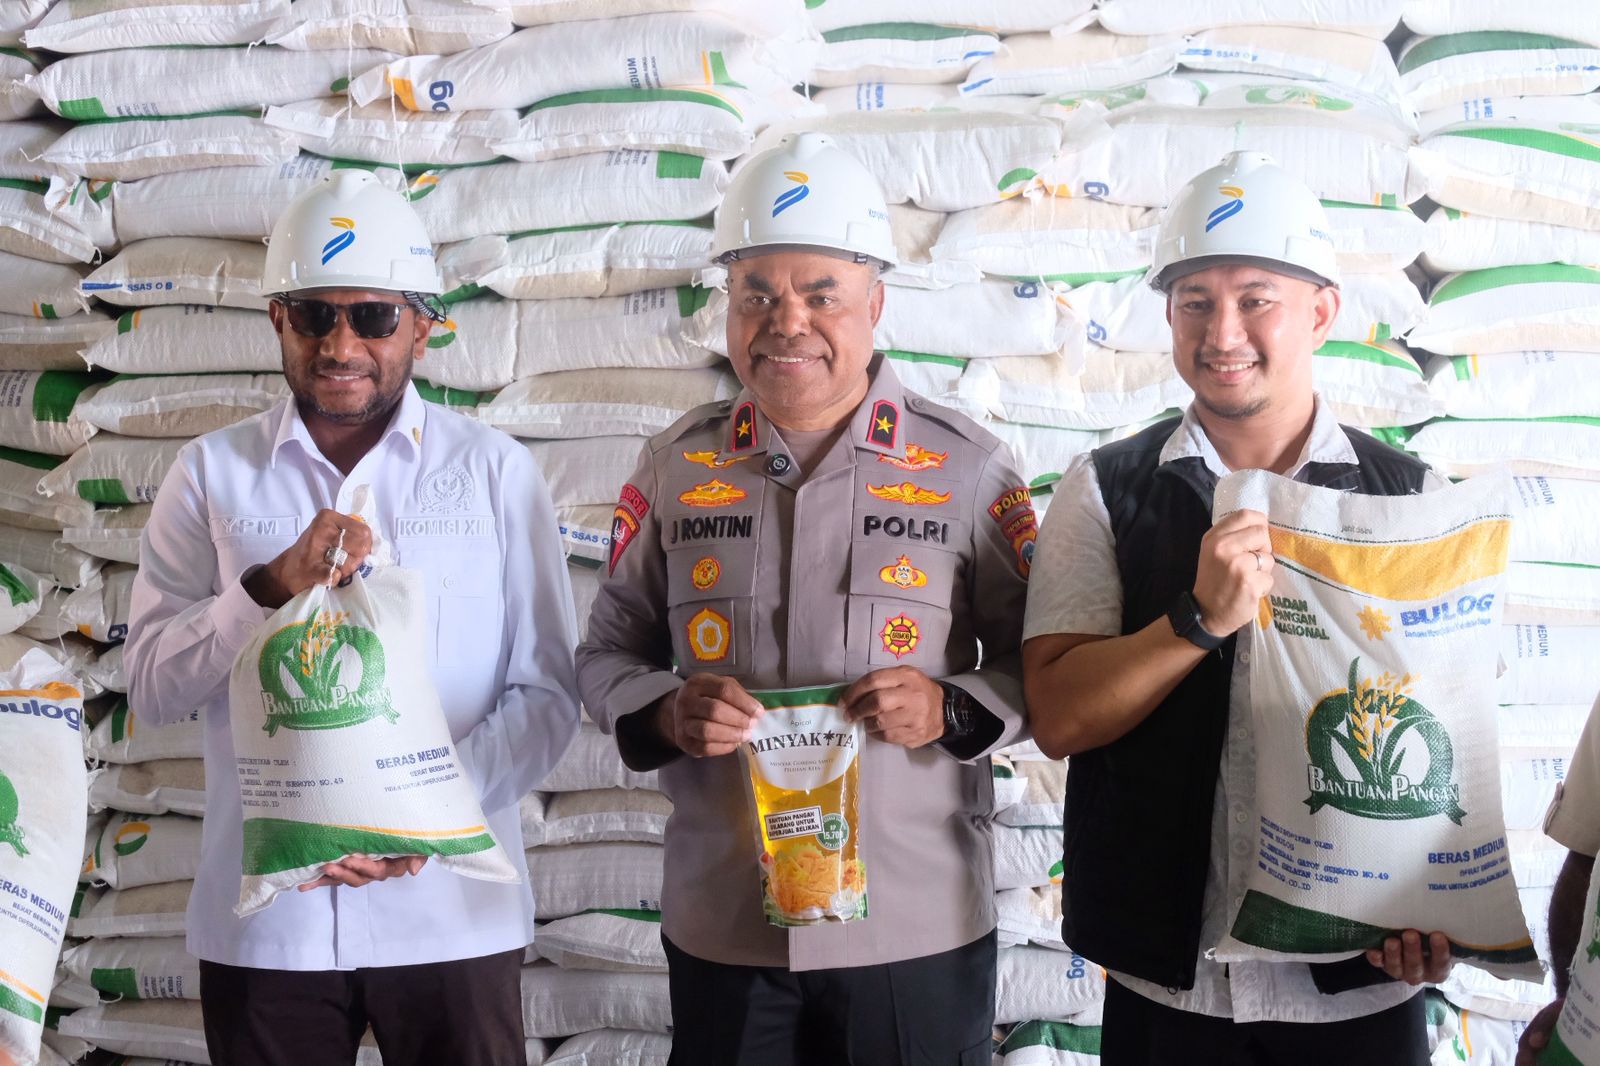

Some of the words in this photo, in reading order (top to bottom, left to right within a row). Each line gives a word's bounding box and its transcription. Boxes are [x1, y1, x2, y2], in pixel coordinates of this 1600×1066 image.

[627, 57, 641, 89] EDIUM
[400, 519, 460, 536] KOMISI
[671, 520, 678, 545] J
[681, 515, 753, 542] RONTINI
[863, 515, 949, 546] POLRI
[1400, 593, 1495, 626] BULOG
[0, 699, 81, 732] ulog
[261, 690, 328, 715] BANTUAN
[376, 754, 416, 769] BERAS
[417, 745, 451, 762] MEDIUM
[1307, 763, 1388, 801] BANTUAN
[1390, 773, 1460, 802] PANGAN
[1428, 850, 1470, 864] BERAS
[1473, 837, 1505, 860] MEDIUM
[30, 893, 65, 924] MEDIUM
